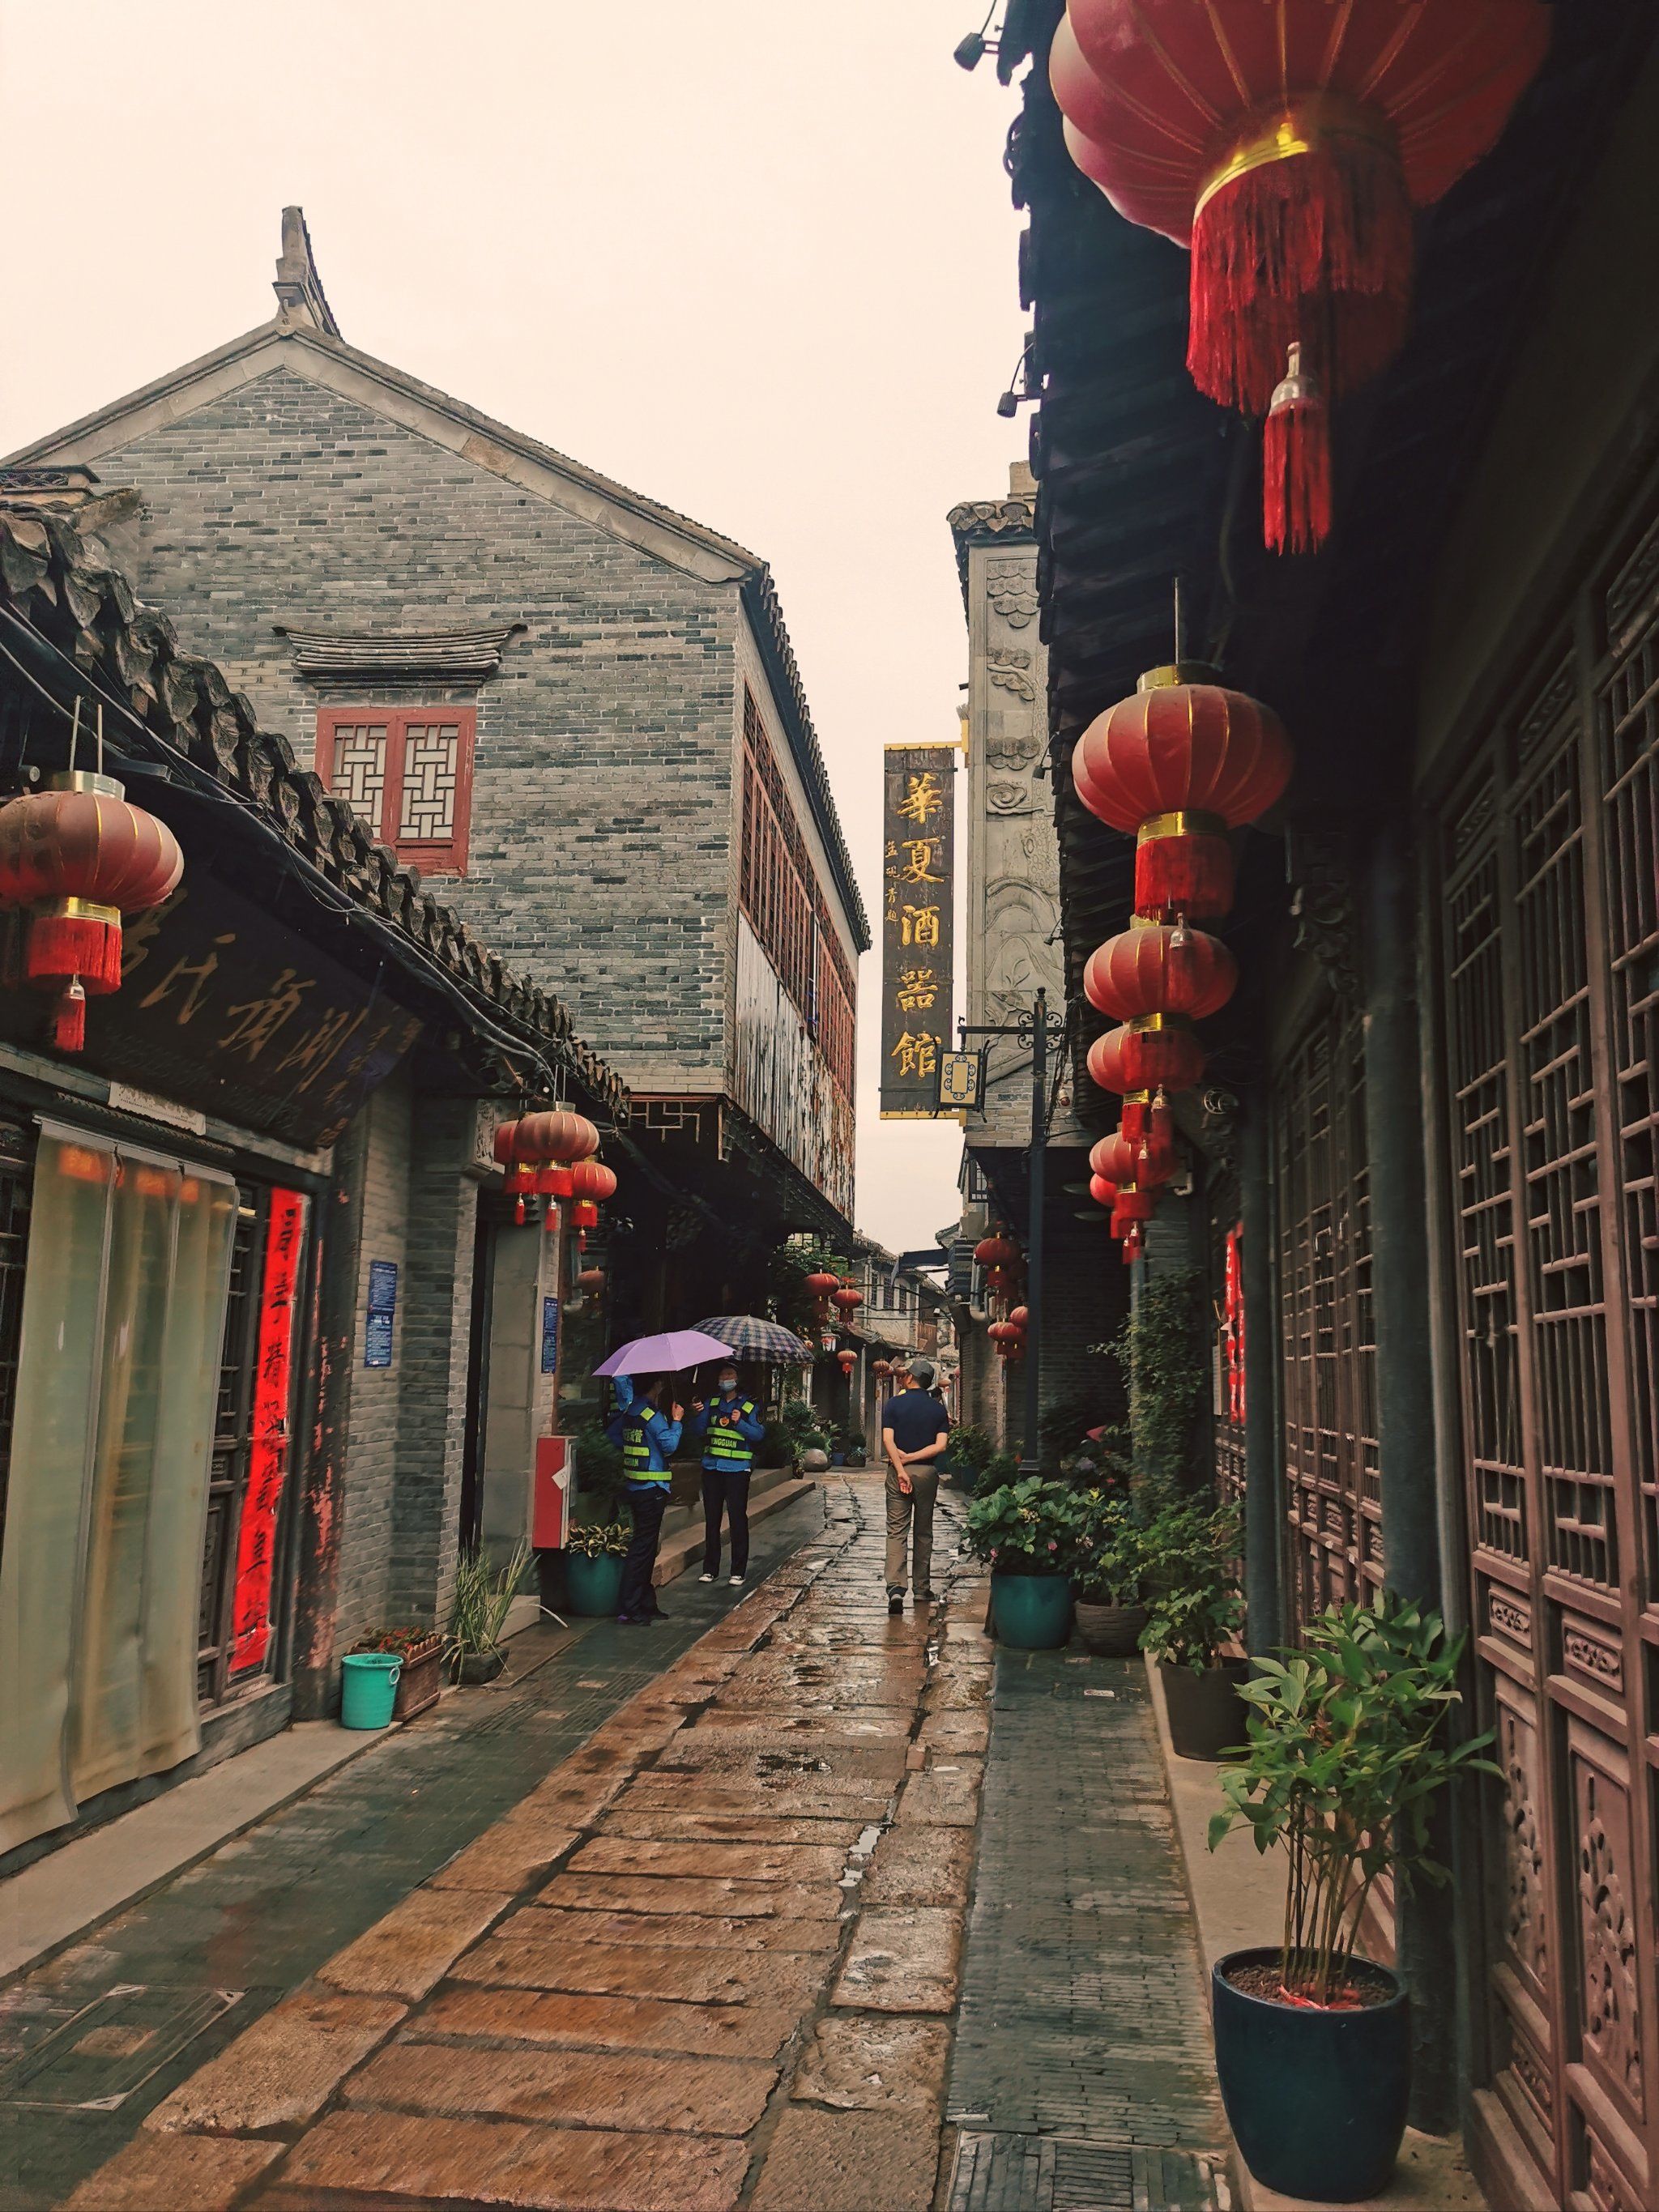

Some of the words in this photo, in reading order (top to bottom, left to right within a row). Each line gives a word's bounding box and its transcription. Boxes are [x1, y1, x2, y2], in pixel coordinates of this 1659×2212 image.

[892, 773, 945, 1078] 華夏酒器館
